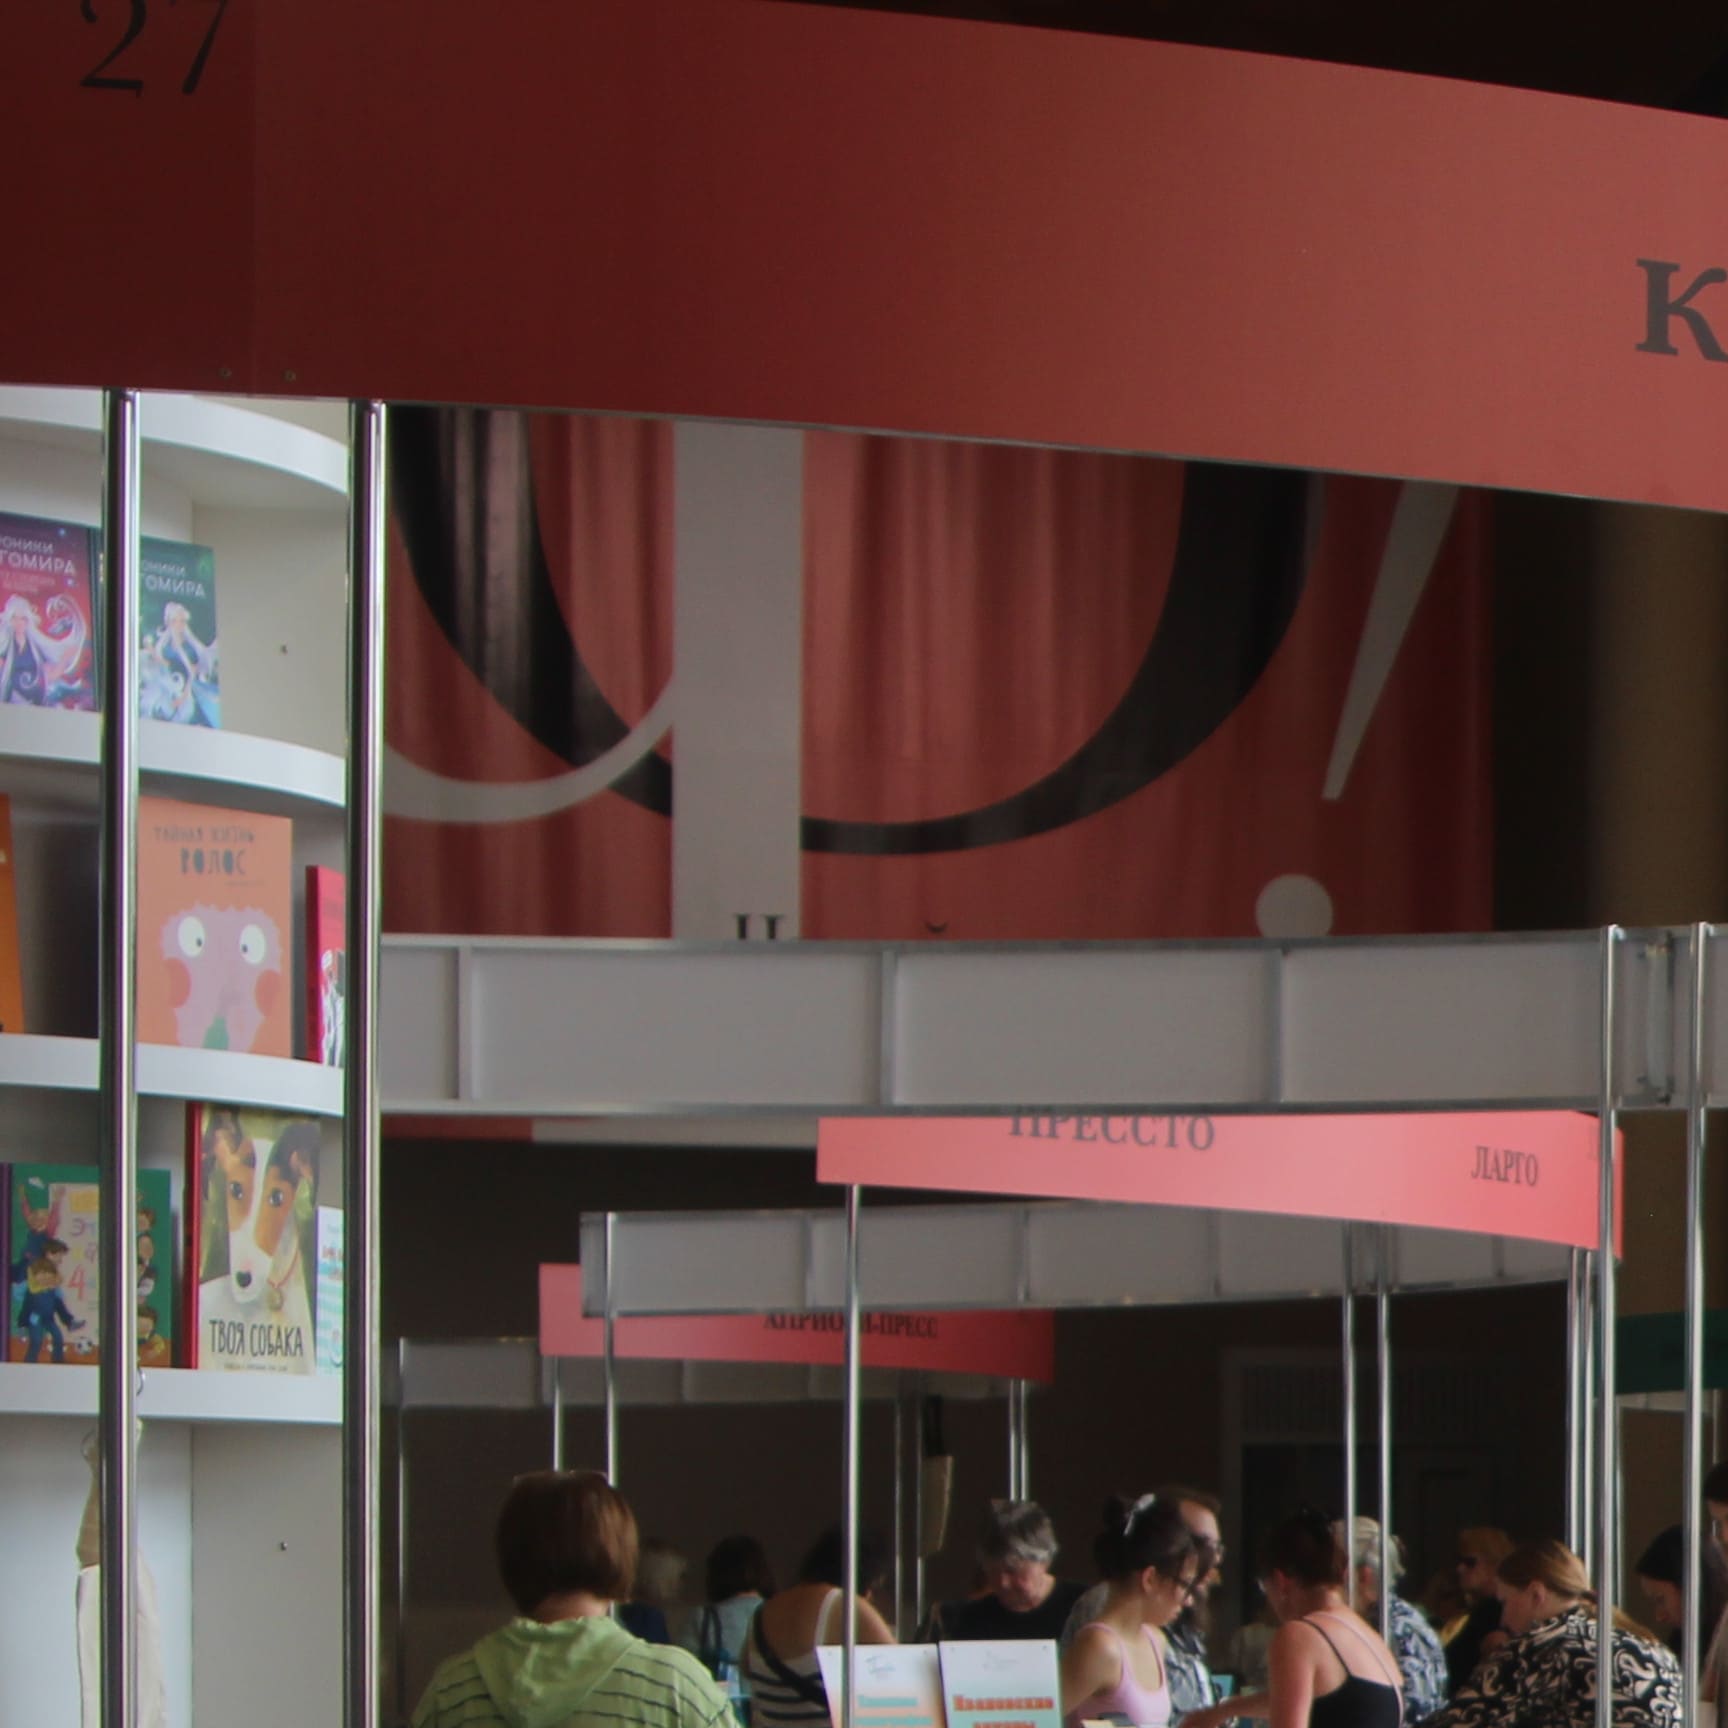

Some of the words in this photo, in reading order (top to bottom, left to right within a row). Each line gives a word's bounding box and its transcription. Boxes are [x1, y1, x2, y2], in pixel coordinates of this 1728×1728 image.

[79, 0, 231, 97] 27
[1007, 1113, 1216, 1152] ПРЕССТО
[1470, 1144, 1540, 1188] ЛАРГО
[209, 1318, 245, 1356] ТВОЯ
[250, 1323, 304, 1358] СОБАКА
[763, 1311, 938, 1339] АПРИОИ-ПРЕСС
